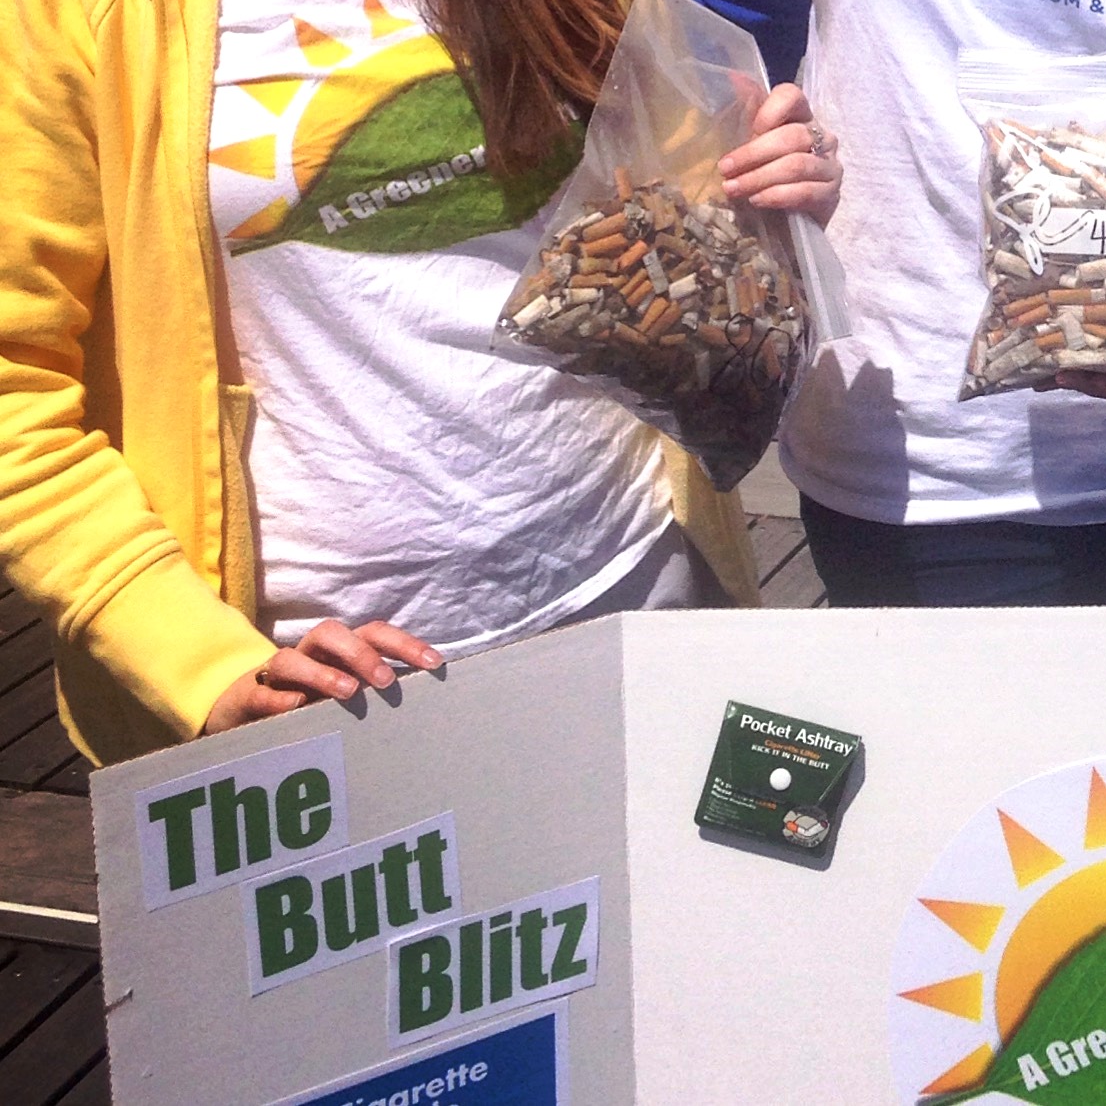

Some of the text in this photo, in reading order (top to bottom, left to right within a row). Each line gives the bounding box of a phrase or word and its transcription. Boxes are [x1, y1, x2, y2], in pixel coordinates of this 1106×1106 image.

[318, 144, 487, 234] A Greener
[740, 714, 853, 757] Pocket Ashtray
[148, 768, 333, 891] The
[255, 829, 452, 978] Butt
[400, 902, 588, 1034] Blitz
[1016, 1053, 1049, 1092] A
